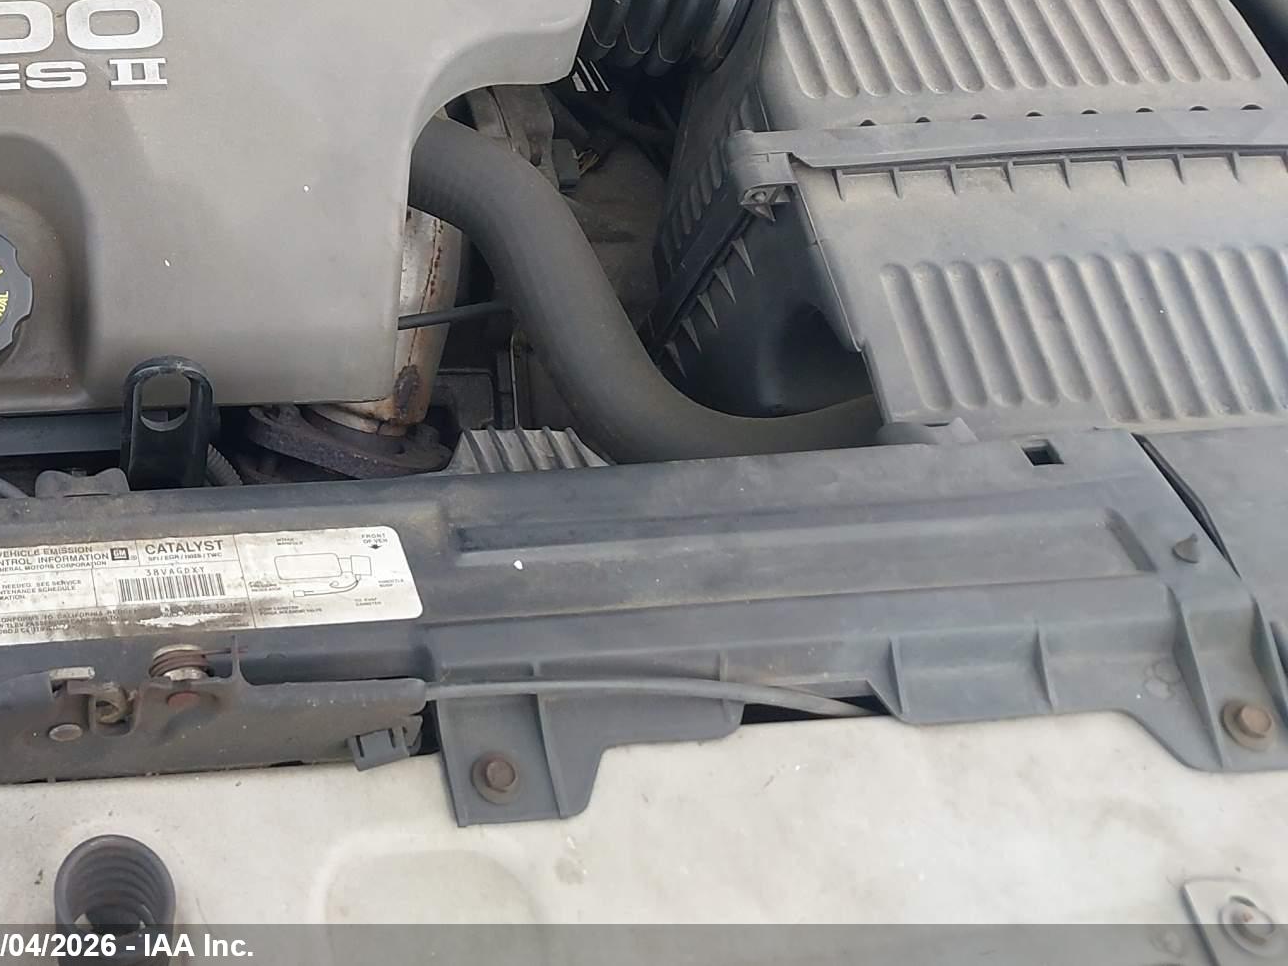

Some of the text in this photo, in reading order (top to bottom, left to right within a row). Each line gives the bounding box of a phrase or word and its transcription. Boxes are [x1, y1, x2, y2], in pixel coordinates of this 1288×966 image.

[108, 58, 168, 88] II
[43, 546, 93, 554] EMISSION
[145, 540, 223, 554] CATALYST
[37, 553, 109, 563] INFORMATION
[56, 561, 107, 569] CORPORATION
